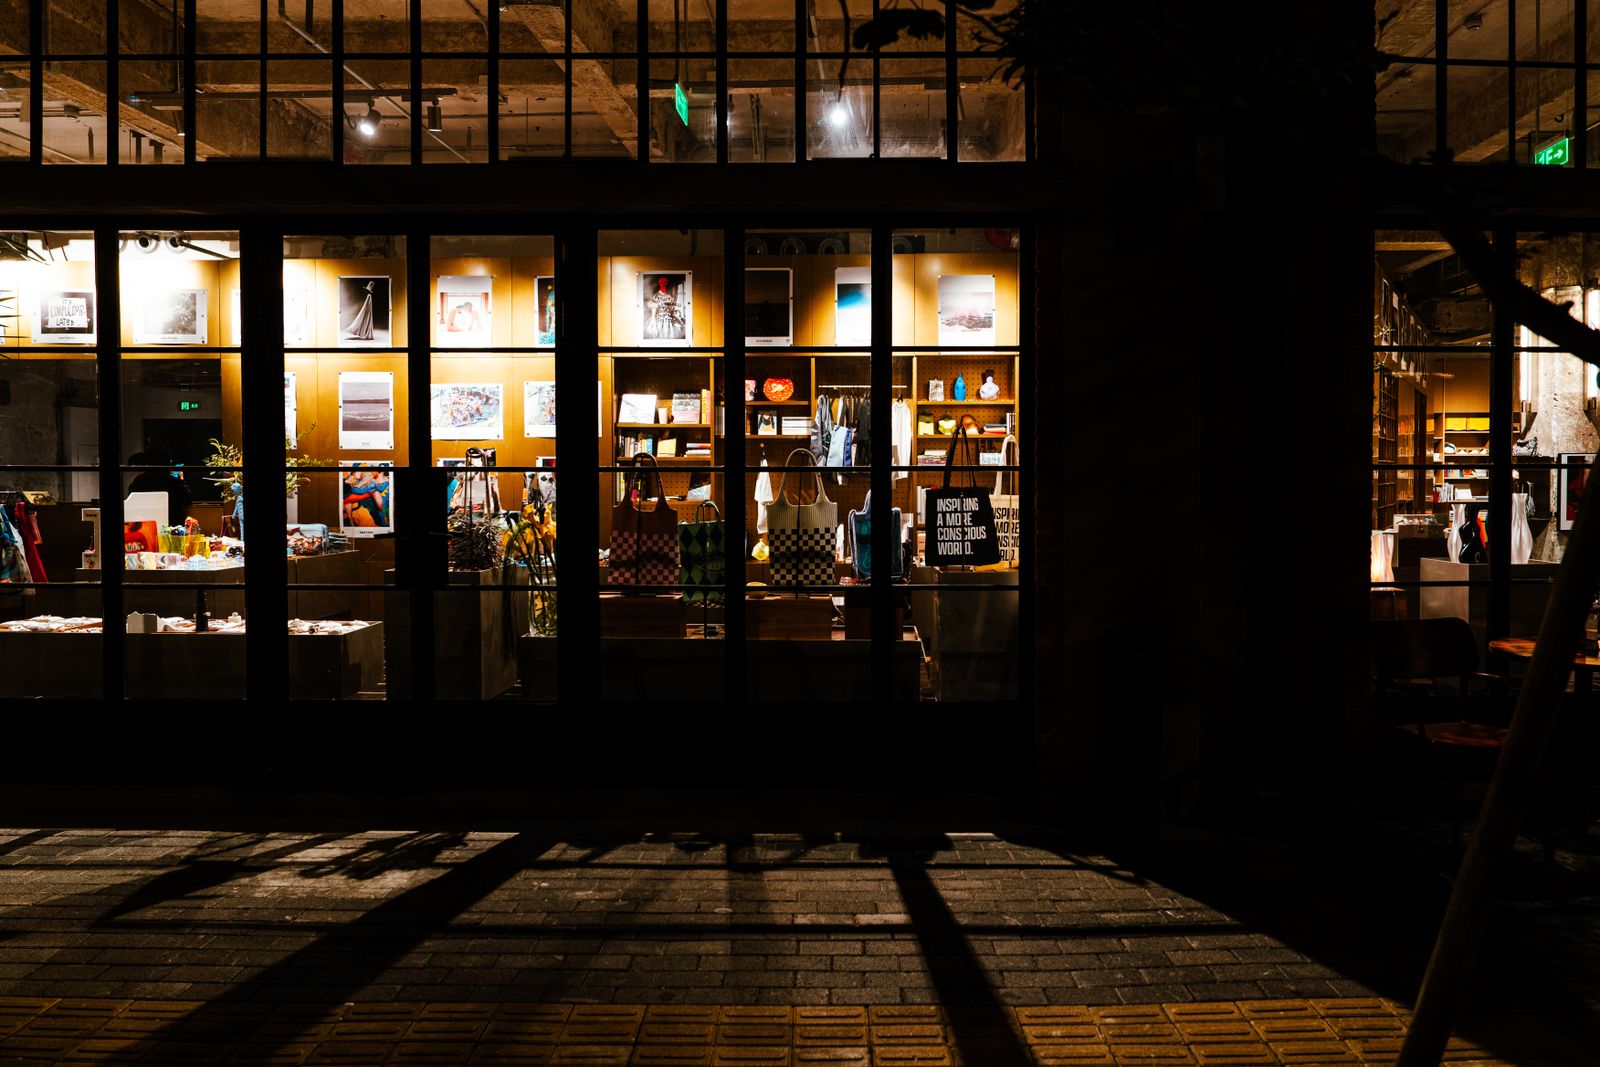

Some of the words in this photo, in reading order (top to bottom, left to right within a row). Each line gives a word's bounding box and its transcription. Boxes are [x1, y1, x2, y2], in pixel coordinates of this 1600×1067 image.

[937, 497, 979, 512] INSPIRING
[937, 513, 943, 526] A
[946, 512, 973, 526] MORE
[937, 526, 987, 541] CONSCIOUS
